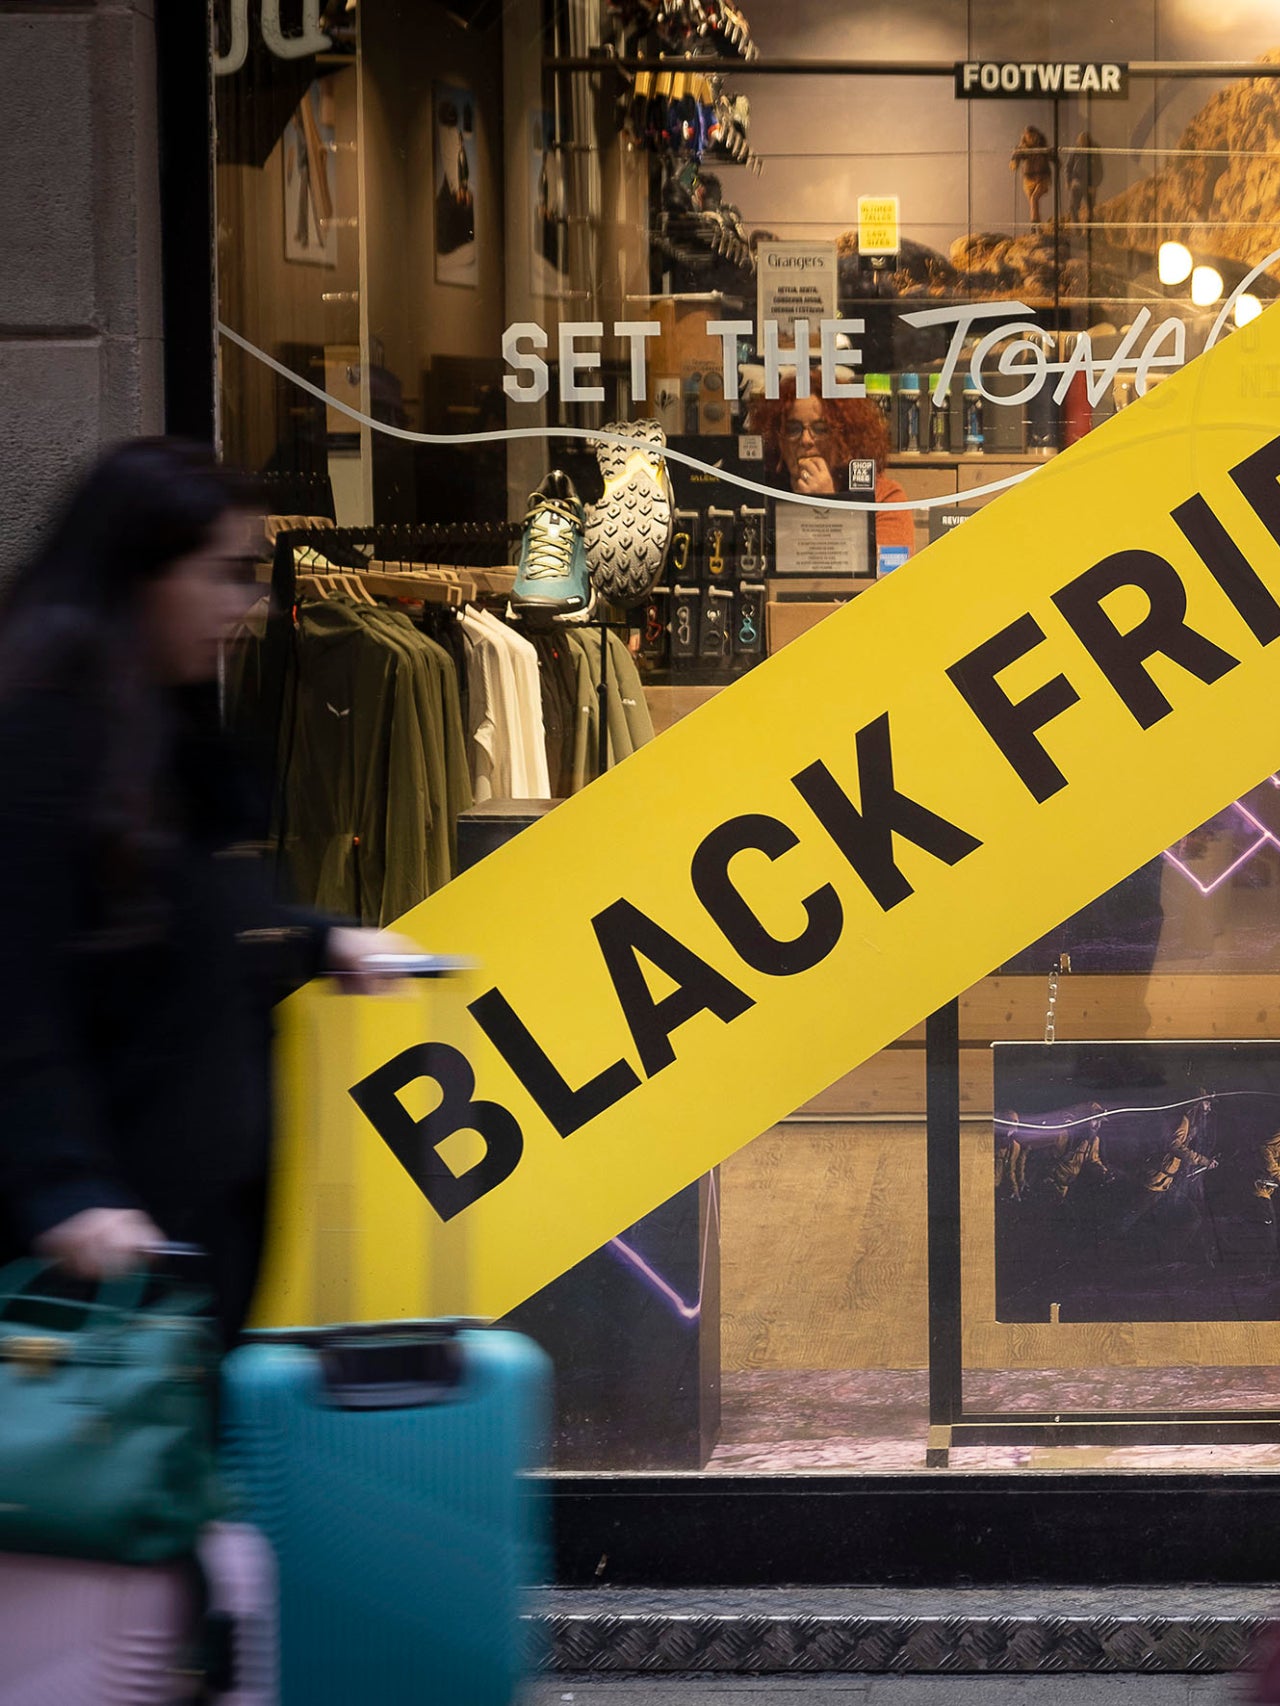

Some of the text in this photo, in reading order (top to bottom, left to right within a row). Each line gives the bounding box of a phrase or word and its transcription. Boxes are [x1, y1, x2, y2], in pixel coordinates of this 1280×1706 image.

[963, 63, 1121, 92] FOOTWEAR
[767, 253, 824, 270] Grangers
[501, 320, 661, 402] SET
[706, 318, 866, 401] THE
[942, 515, 970, 525] REVIE
[348, 711, 984, 1223] BLACK
